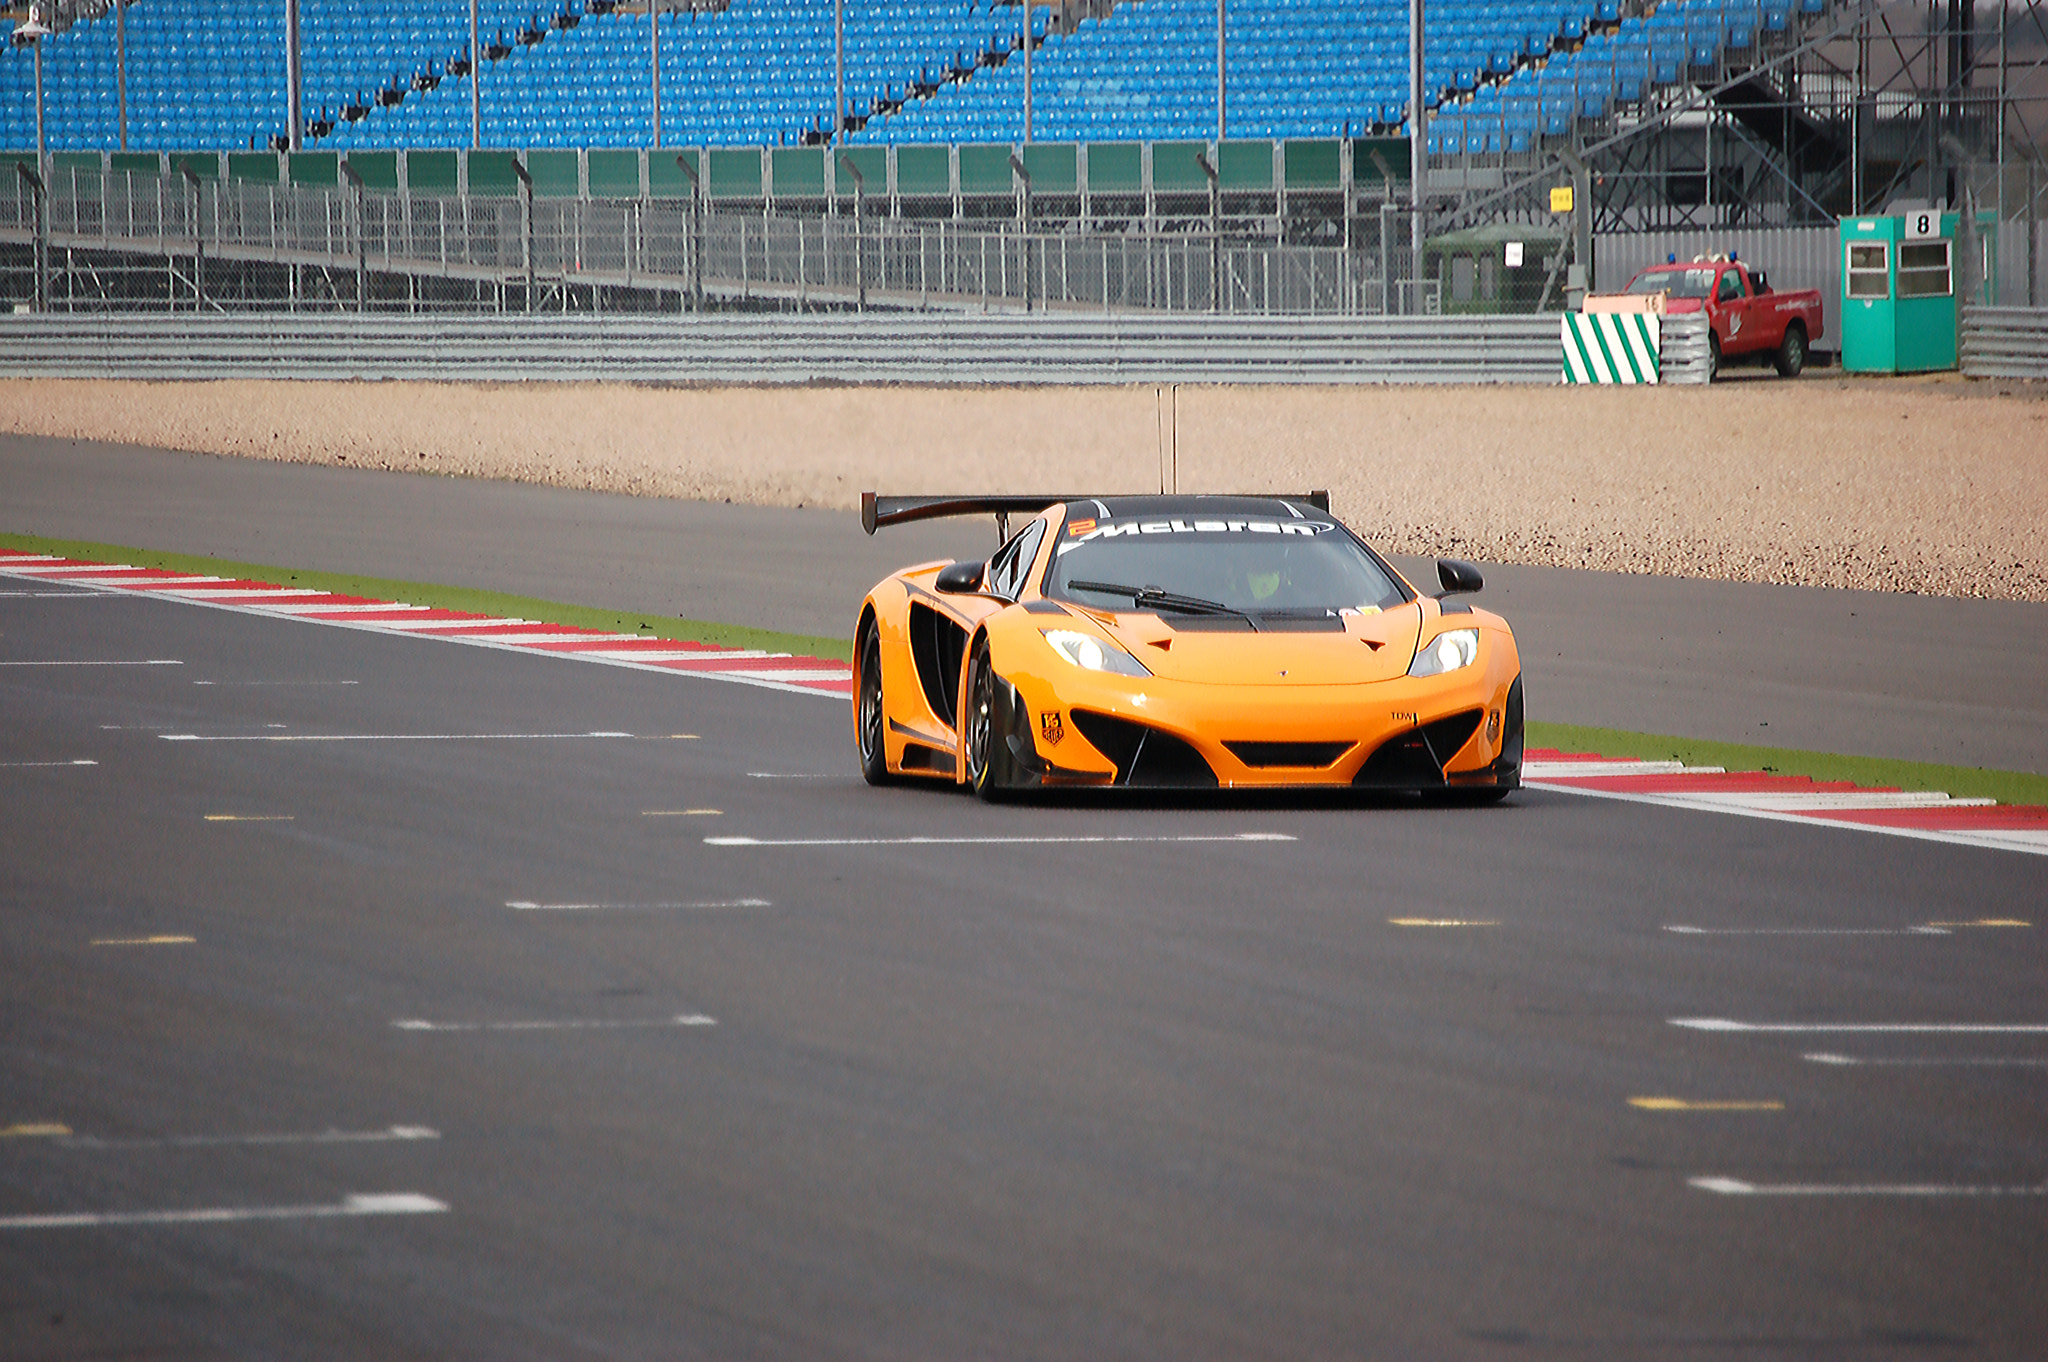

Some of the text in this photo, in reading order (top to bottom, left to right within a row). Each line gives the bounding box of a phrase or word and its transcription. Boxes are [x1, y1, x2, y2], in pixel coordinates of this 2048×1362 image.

[1917, 214, 1930, 234] 8
[1068, 519, 1097, 537] 2
[1079, 519, 1316, 542] McLaren
[1391, 712, 1412, 720] TOW
